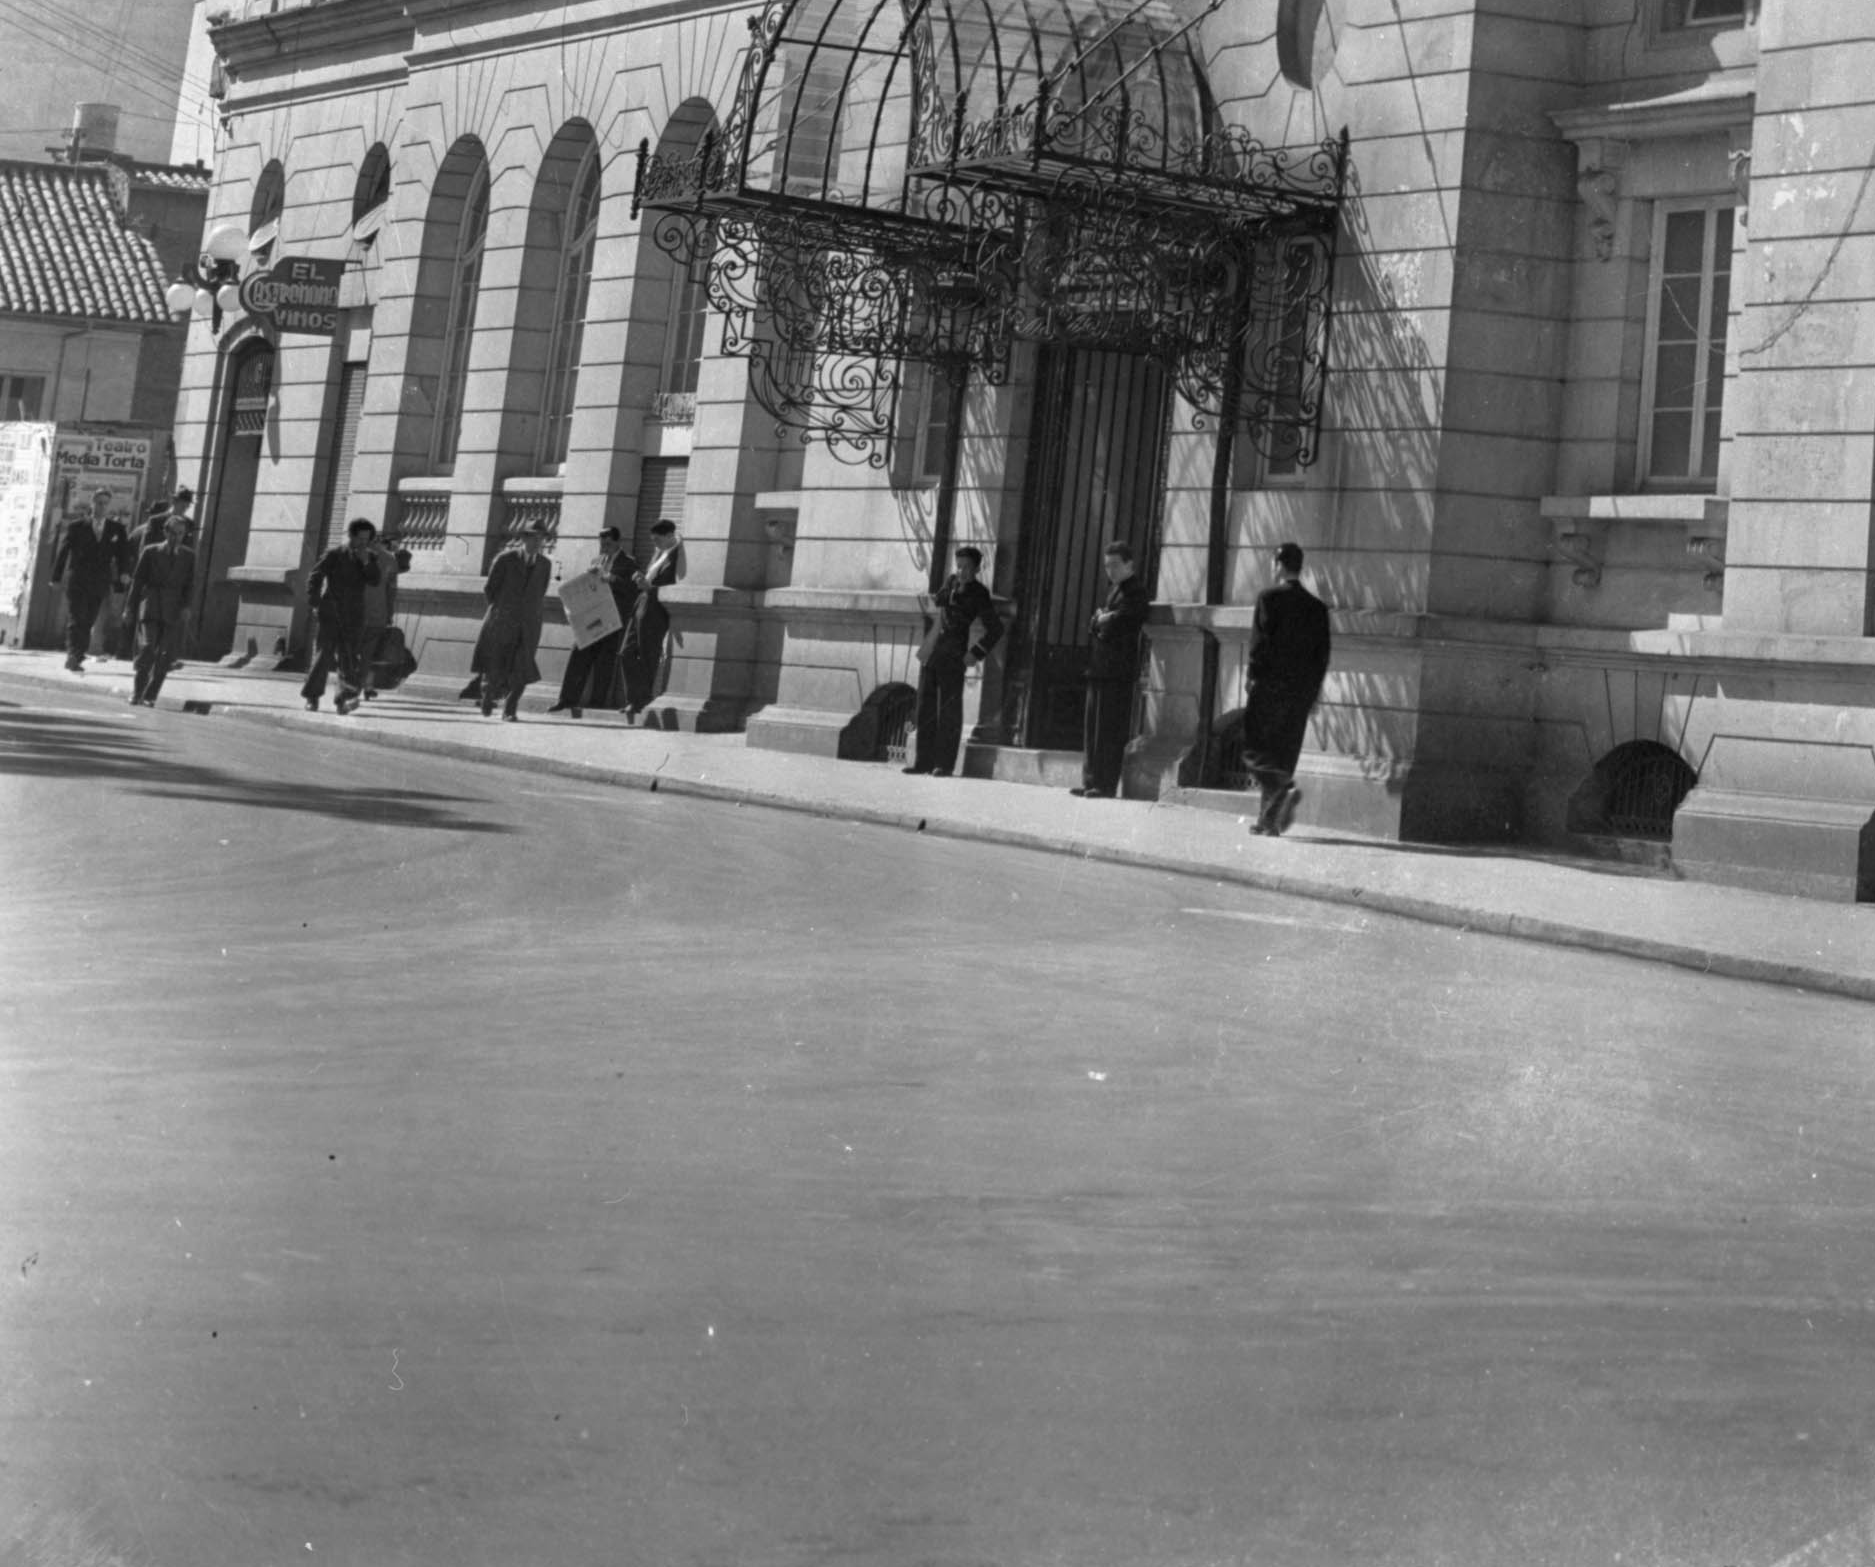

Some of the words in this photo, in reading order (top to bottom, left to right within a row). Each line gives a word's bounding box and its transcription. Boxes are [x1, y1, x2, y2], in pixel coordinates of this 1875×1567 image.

[291, 262, 326, 281] EL
[95, 437, 147, 454] Teatro
[56, 451, 100, 466] Media
[103, 453, 145, 469] Torta
